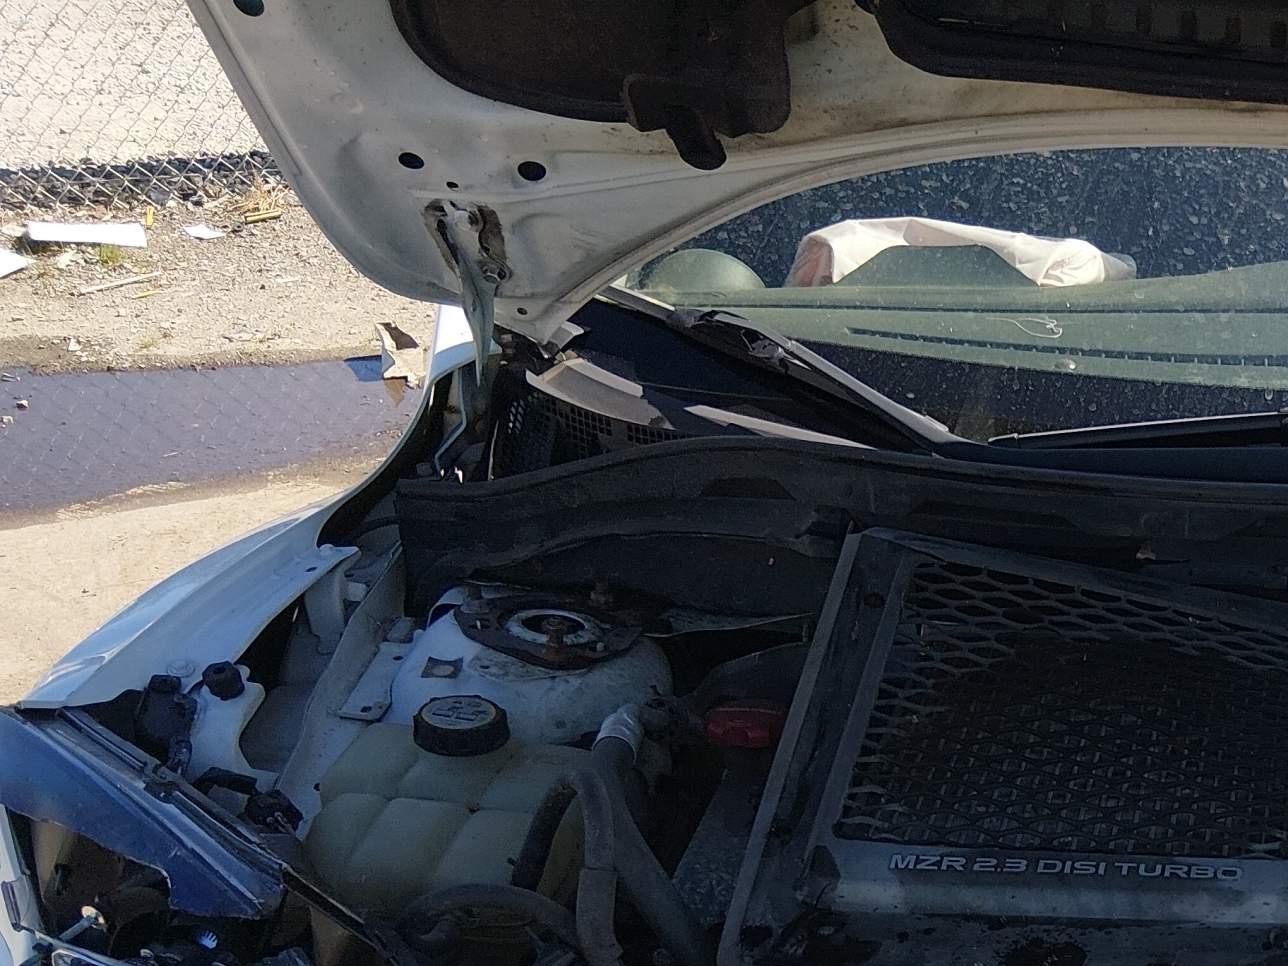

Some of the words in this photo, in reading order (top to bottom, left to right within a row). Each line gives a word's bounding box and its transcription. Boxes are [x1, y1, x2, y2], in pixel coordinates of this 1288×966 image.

[889, 854, 966, 872] MZR
[972, 857, 1028, 873] 2.3
[1037, 860, 1107, 876] DISI
[1114, 862, 1244, 880] TURBO
